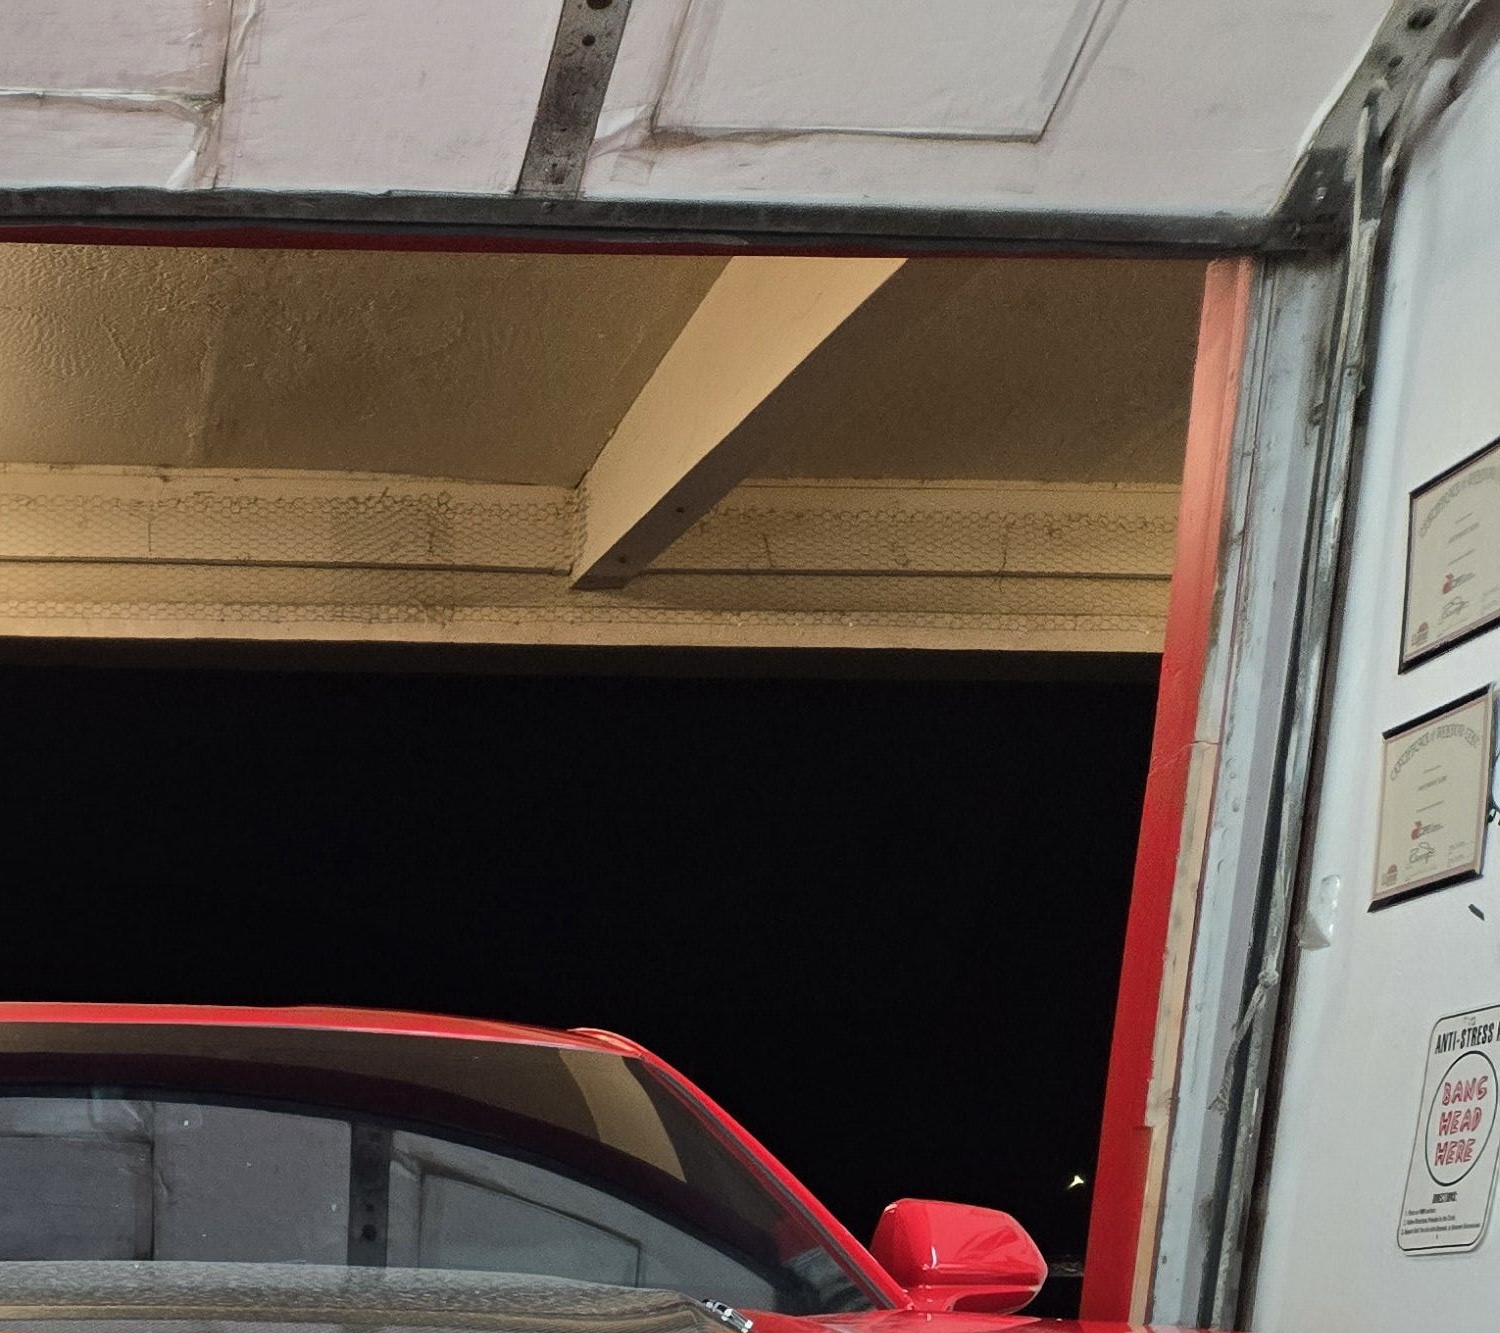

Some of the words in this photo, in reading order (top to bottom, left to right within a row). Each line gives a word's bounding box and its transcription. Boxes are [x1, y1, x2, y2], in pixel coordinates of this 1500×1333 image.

[1434, 1022, 1495, 1055] ANTI-STRESS
[1441, 1075, 1488, 1107] BANG
[1438, 1107, 1483, 1136] HEAD
[1434, 1138, 1476, 1167] HERE
